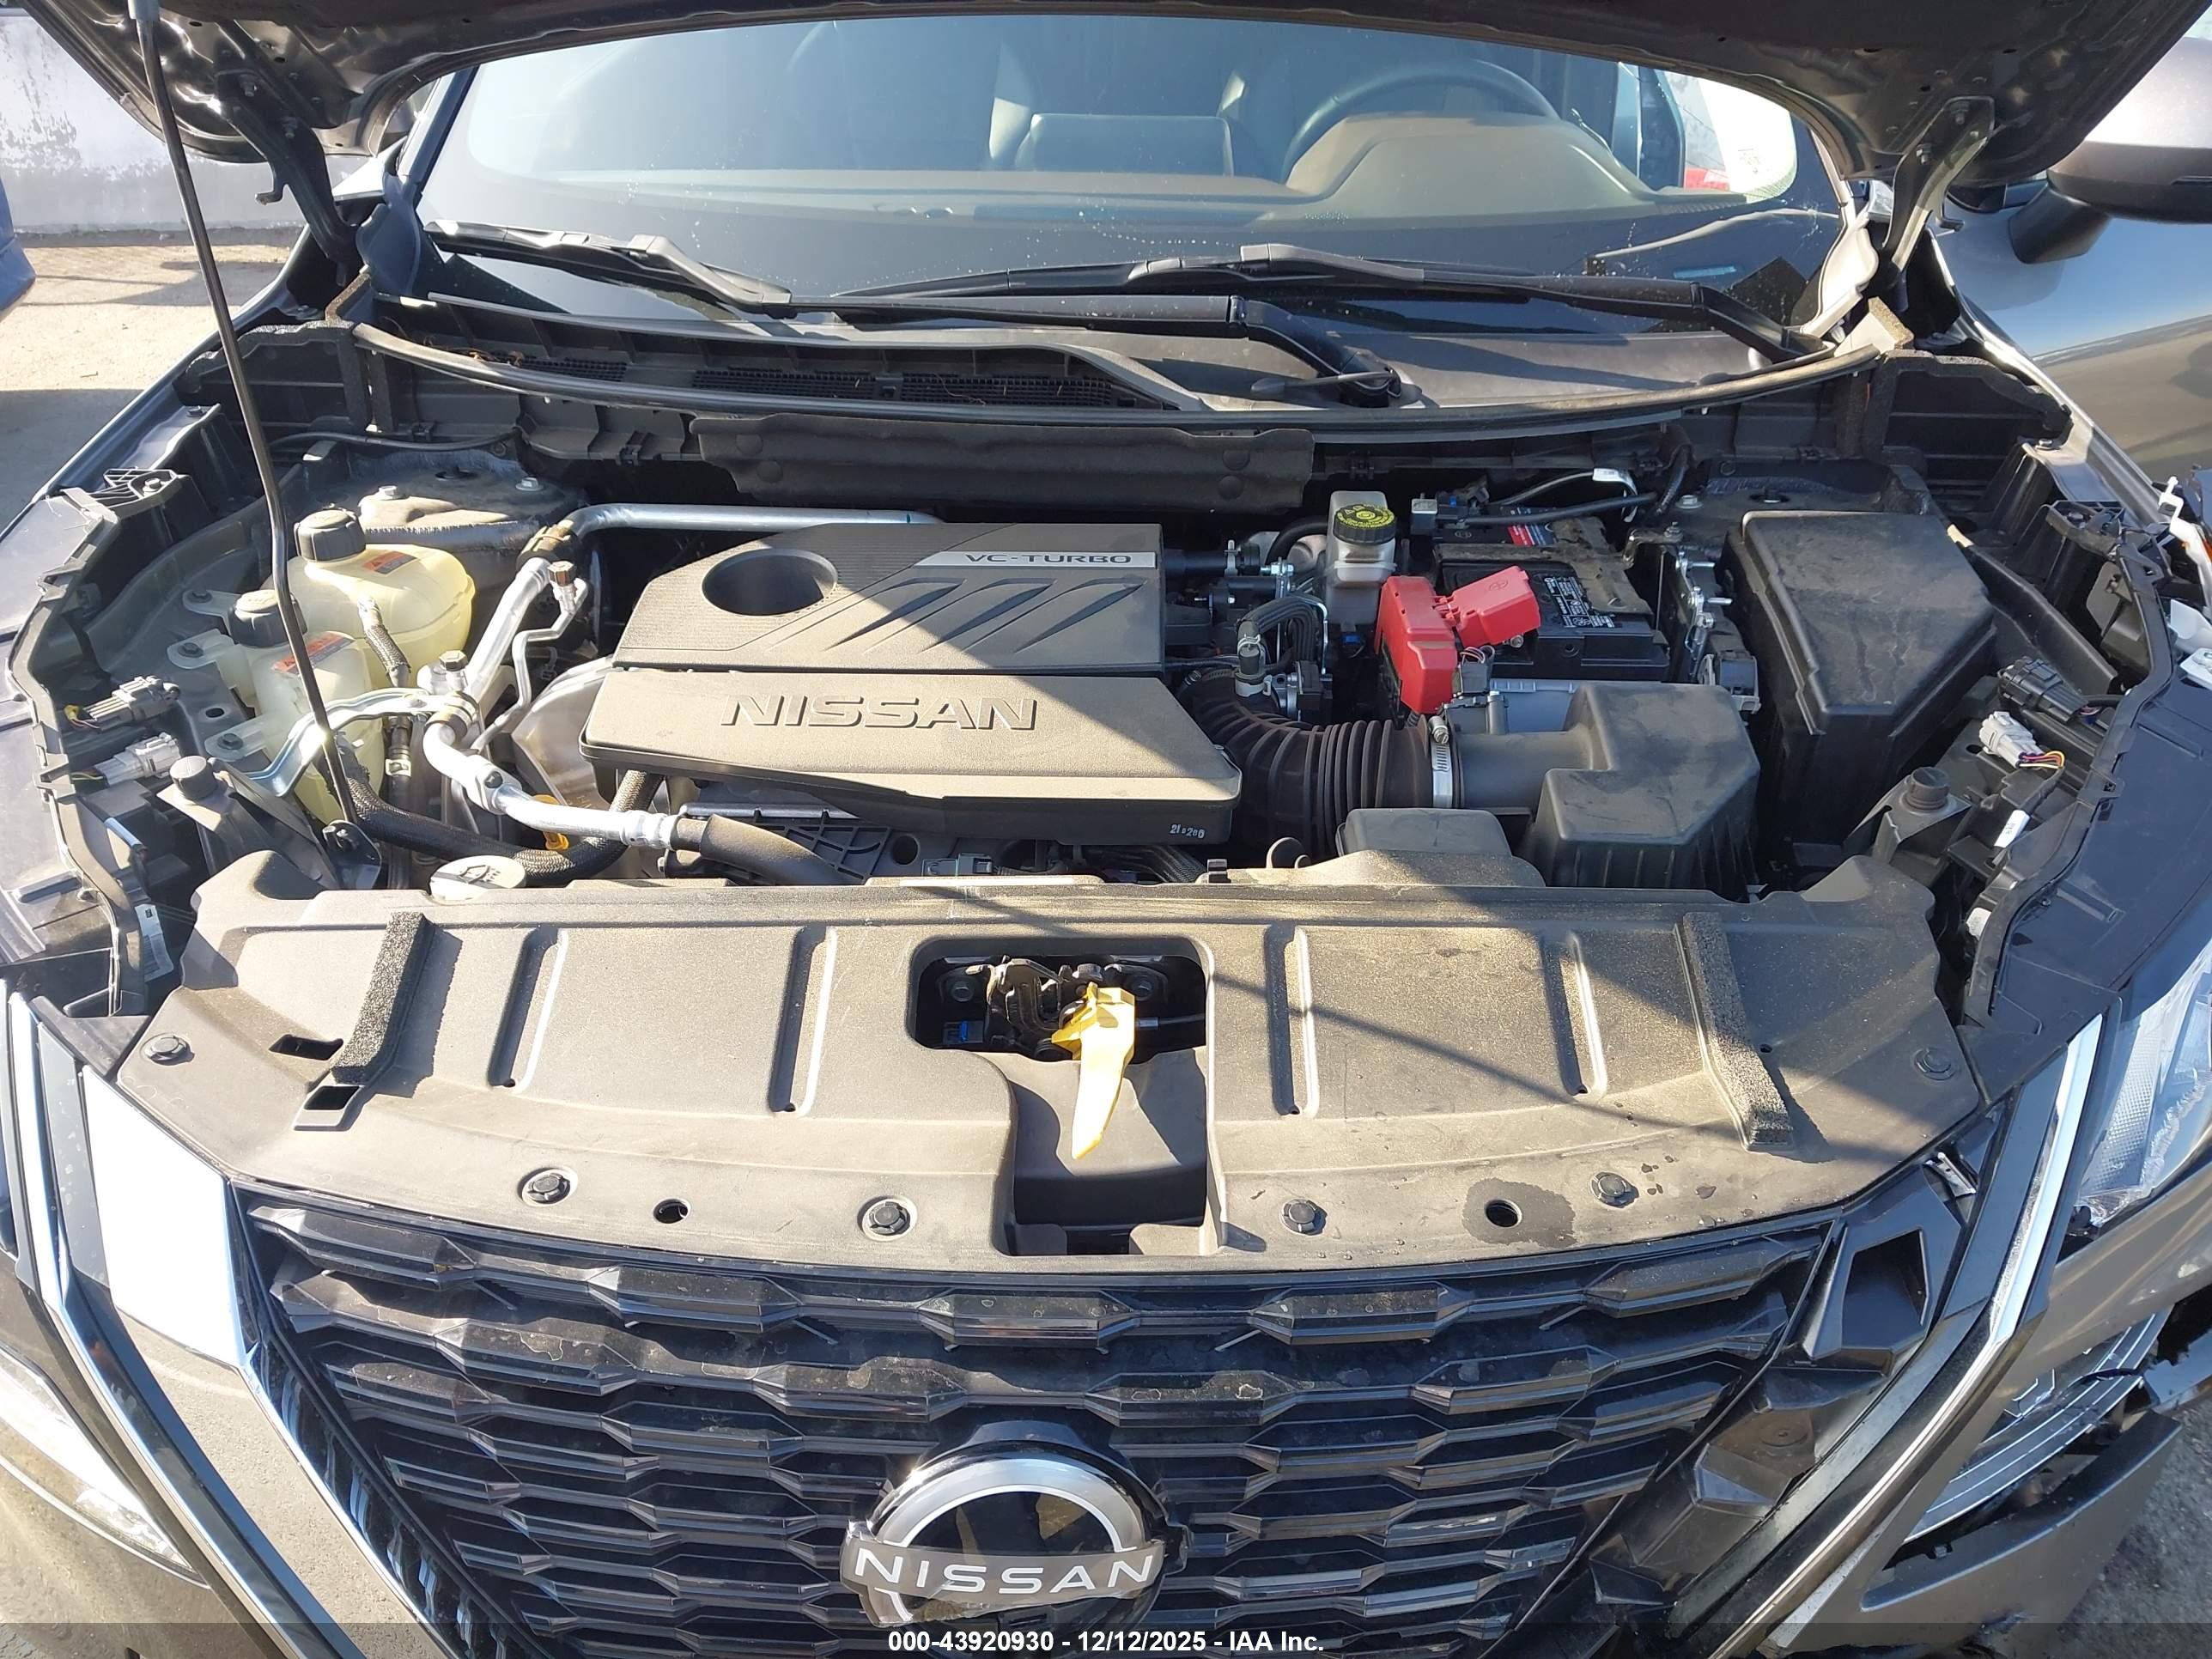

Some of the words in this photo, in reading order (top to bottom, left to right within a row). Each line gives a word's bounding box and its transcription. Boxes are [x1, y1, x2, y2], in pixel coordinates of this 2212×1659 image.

[965, 554, 1132, 564] VC-TURBO
[720, 695, 1038, 731] NISSAN
[854, 1547, 1153, 1595] NISSAN
